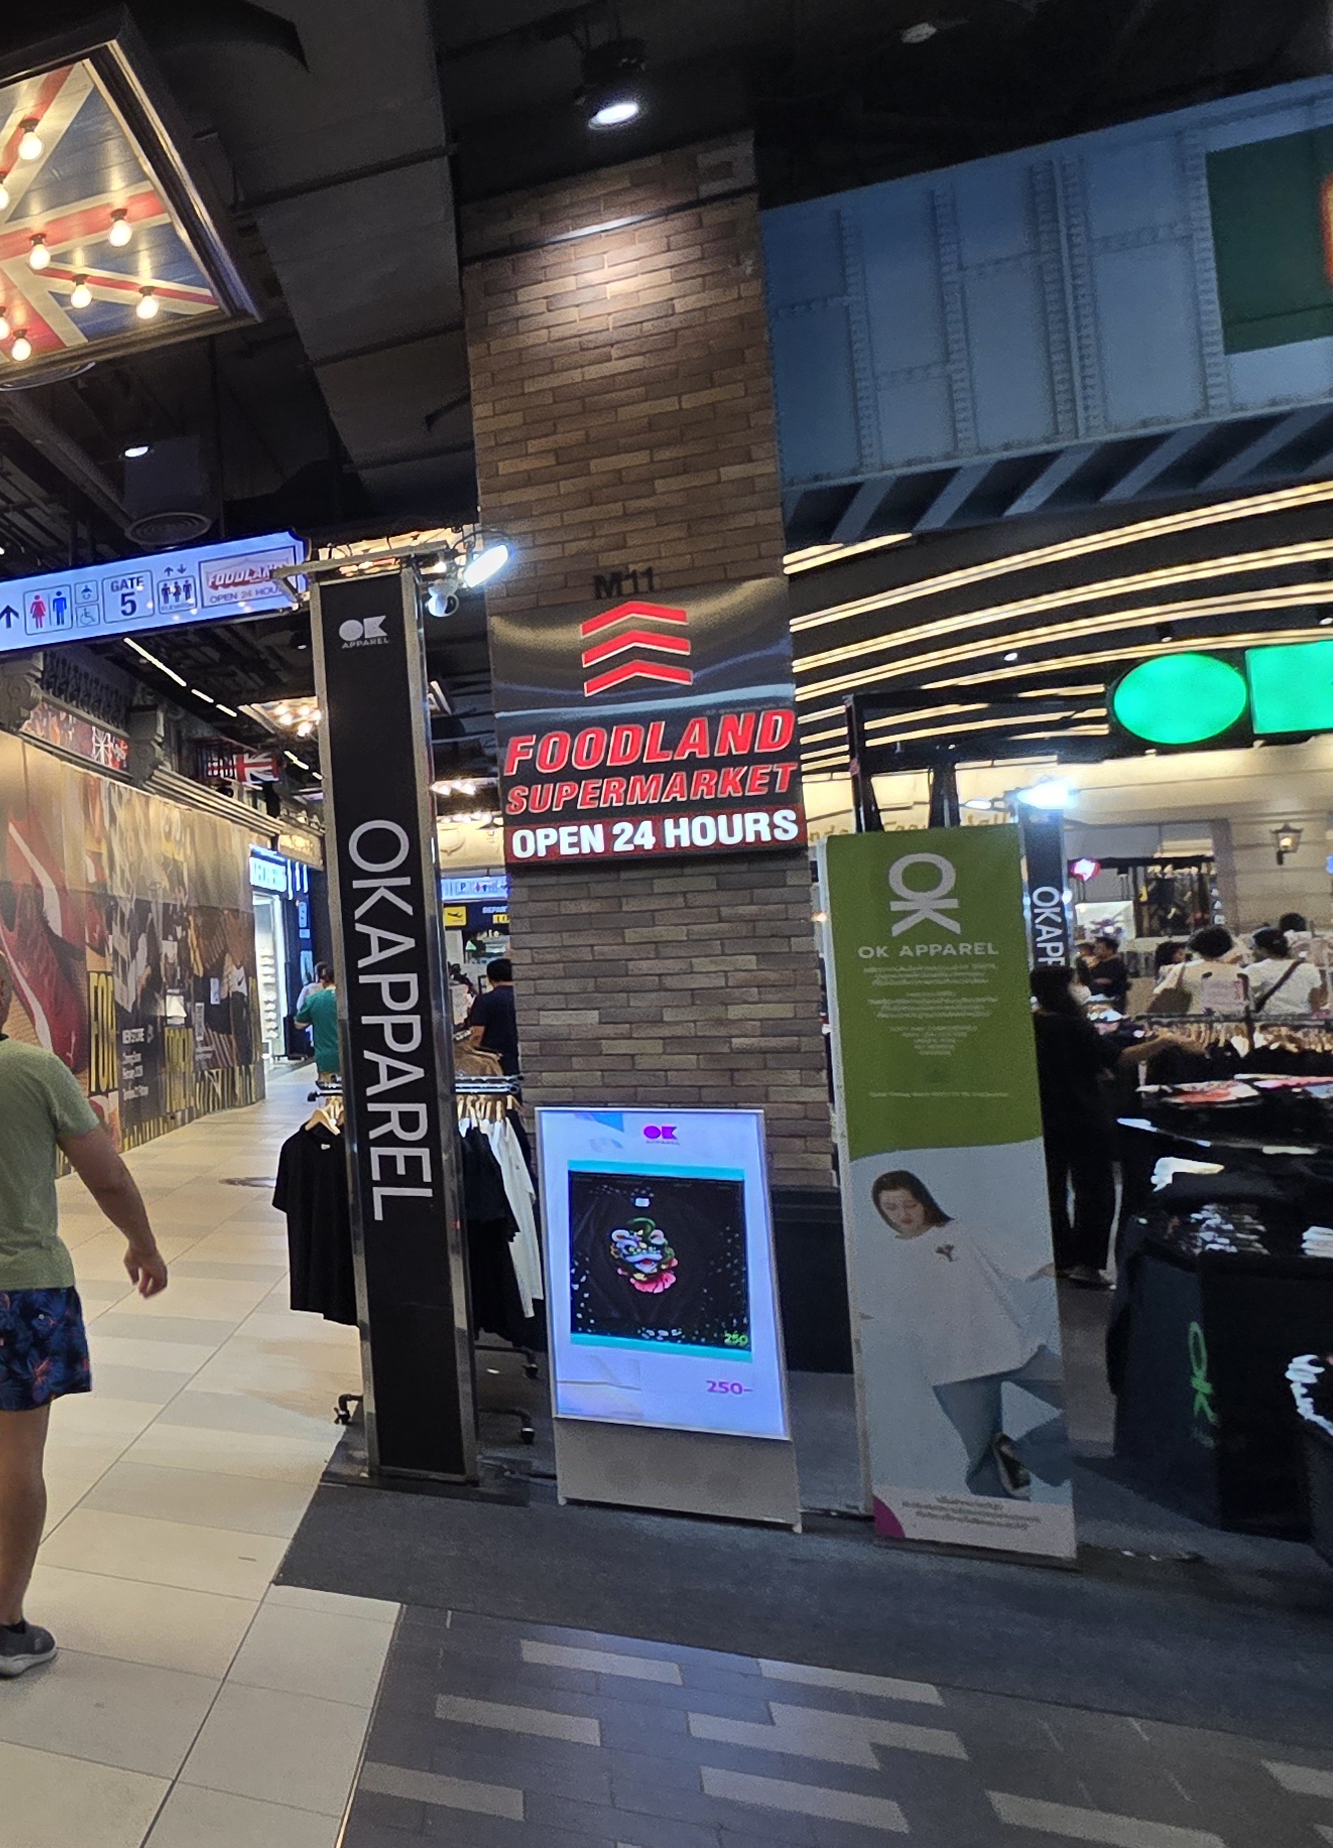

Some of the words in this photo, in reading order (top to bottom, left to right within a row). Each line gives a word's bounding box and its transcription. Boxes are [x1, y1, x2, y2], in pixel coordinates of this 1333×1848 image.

[111, 576, 144, 593] GATE
[209, 592, 239, 604] OPEN
[241, 589, 252, 600] 24
[120, 592, 137, 616] 5
[339, 615, 387, 641] OK
[503, 709, 795, 776] FOODLAND
[505, 762, 798, 815] SUPERMARKET
[512, 824, 604, 859] OPEN
[612, 820, 655, 851] 24
[664, 809, 799, 848] HOURS
[889, 853, 961, 937] OK
[858, 946, 889, 959] OK
[898, 942, 999, 957] APPAREL
[644, 1125, 677, 1139] OK
